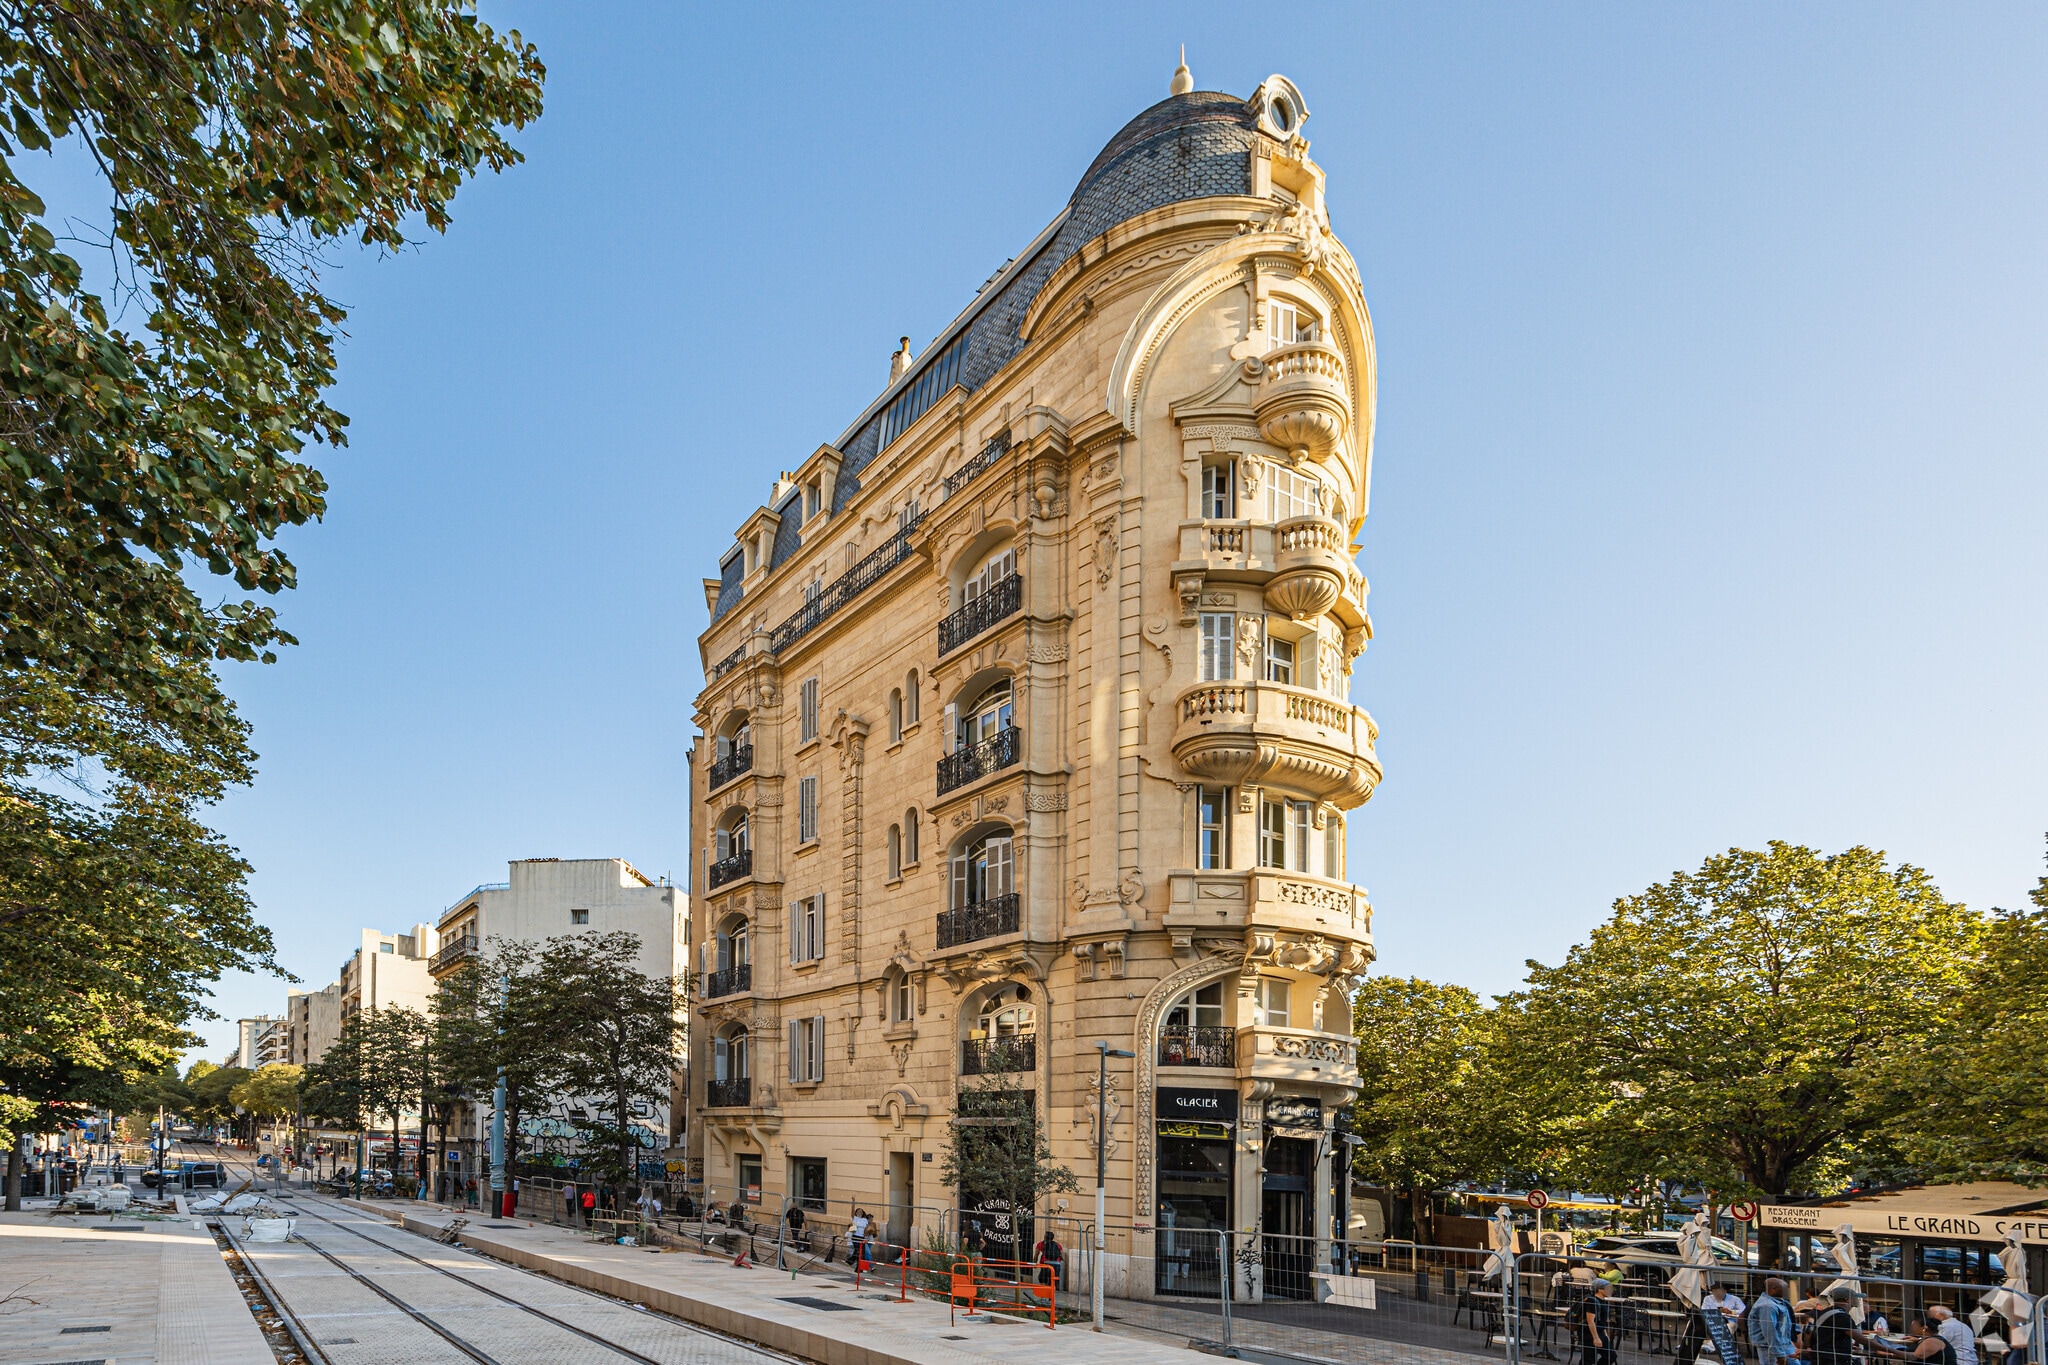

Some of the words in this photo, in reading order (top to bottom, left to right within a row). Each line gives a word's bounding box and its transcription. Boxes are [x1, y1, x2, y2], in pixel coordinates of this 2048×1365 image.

[1176, 1097, 1218, 1108] GLACIER
[984, 1199, 1011, 1210] GRAND
[1767, 1207, 1821, 1218] RESTAURANT
[1772, 1216, 1818, 1226] BRASSERIE
[1888, 1215, 1910, 1231] LE
[1914, 1217, 1981, 1235] GRAND
[984, 1228, 1023, 1244] BRASSERE
